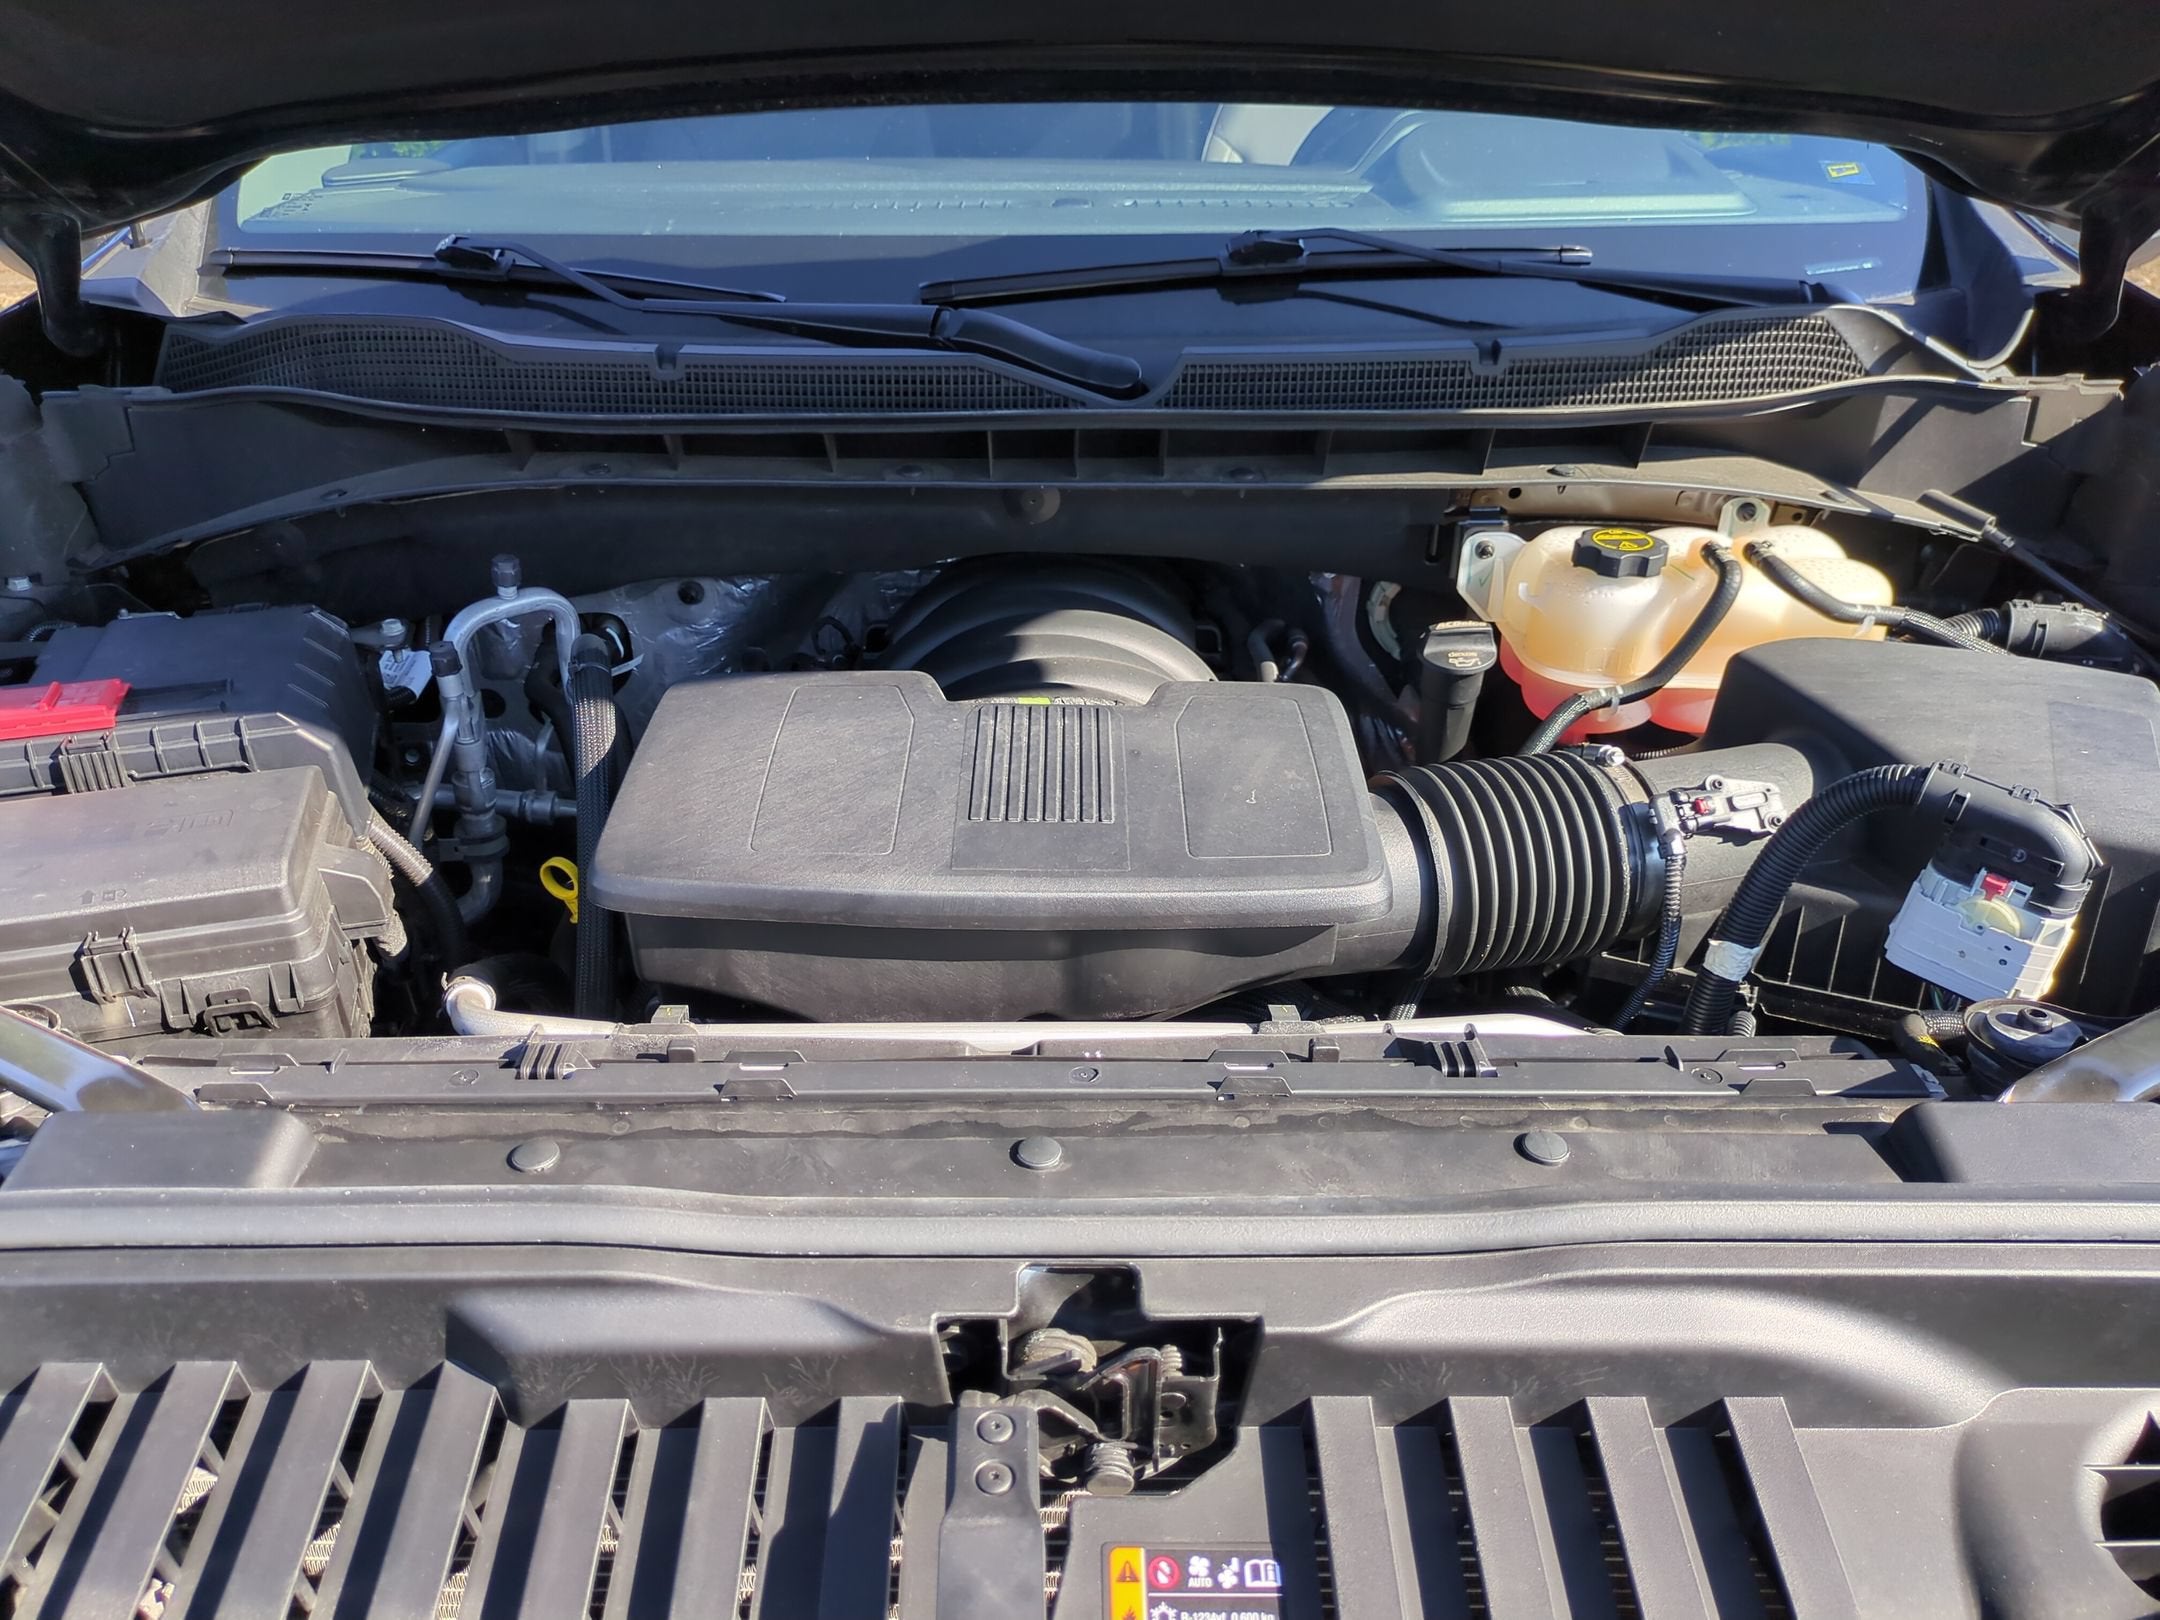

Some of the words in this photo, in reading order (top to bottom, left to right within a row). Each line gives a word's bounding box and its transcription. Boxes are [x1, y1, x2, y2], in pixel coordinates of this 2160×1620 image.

[1435, 620, 1488, 630] ACDelco
[1188, 1577, 1213, 1588] AUTO
[1231, 1611, 1259, 1620] 0600
